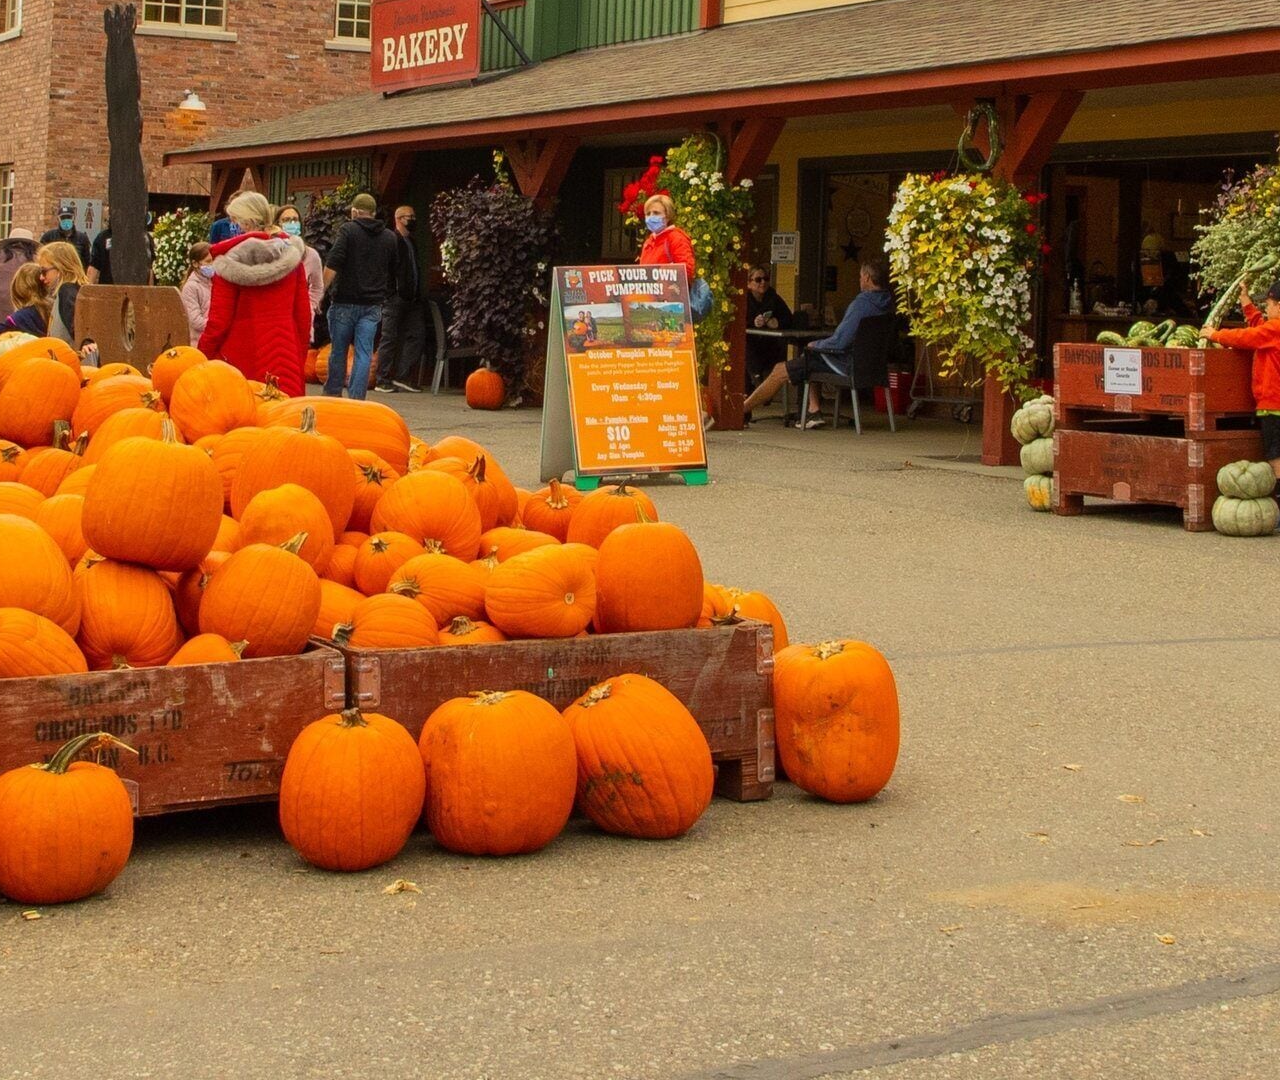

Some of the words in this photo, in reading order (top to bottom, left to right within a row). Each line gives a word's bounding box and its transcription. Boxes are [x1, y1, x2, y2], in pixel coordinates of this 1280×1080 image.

[382, 22, 468, 72] BAKERY
[588, 269, 615, 283] PICK
[618, 268, 647, 281] YOUR
[651, 268, 677, 281] OWN
[605, 282, 664, 296] PUMPKINS!
[588, 350, 613, 359] October
[616, 349, 645, 359] Pumpkin
[648, 348, 673, 358] Picking
[591, 382, 610, 392] Every
[612, 382, 648, 391] Wednesday
[611, 394, 628, 402] 10am
[637, 392, 662, 402] 4:30pm
[607, 425, 630, 441] $10
